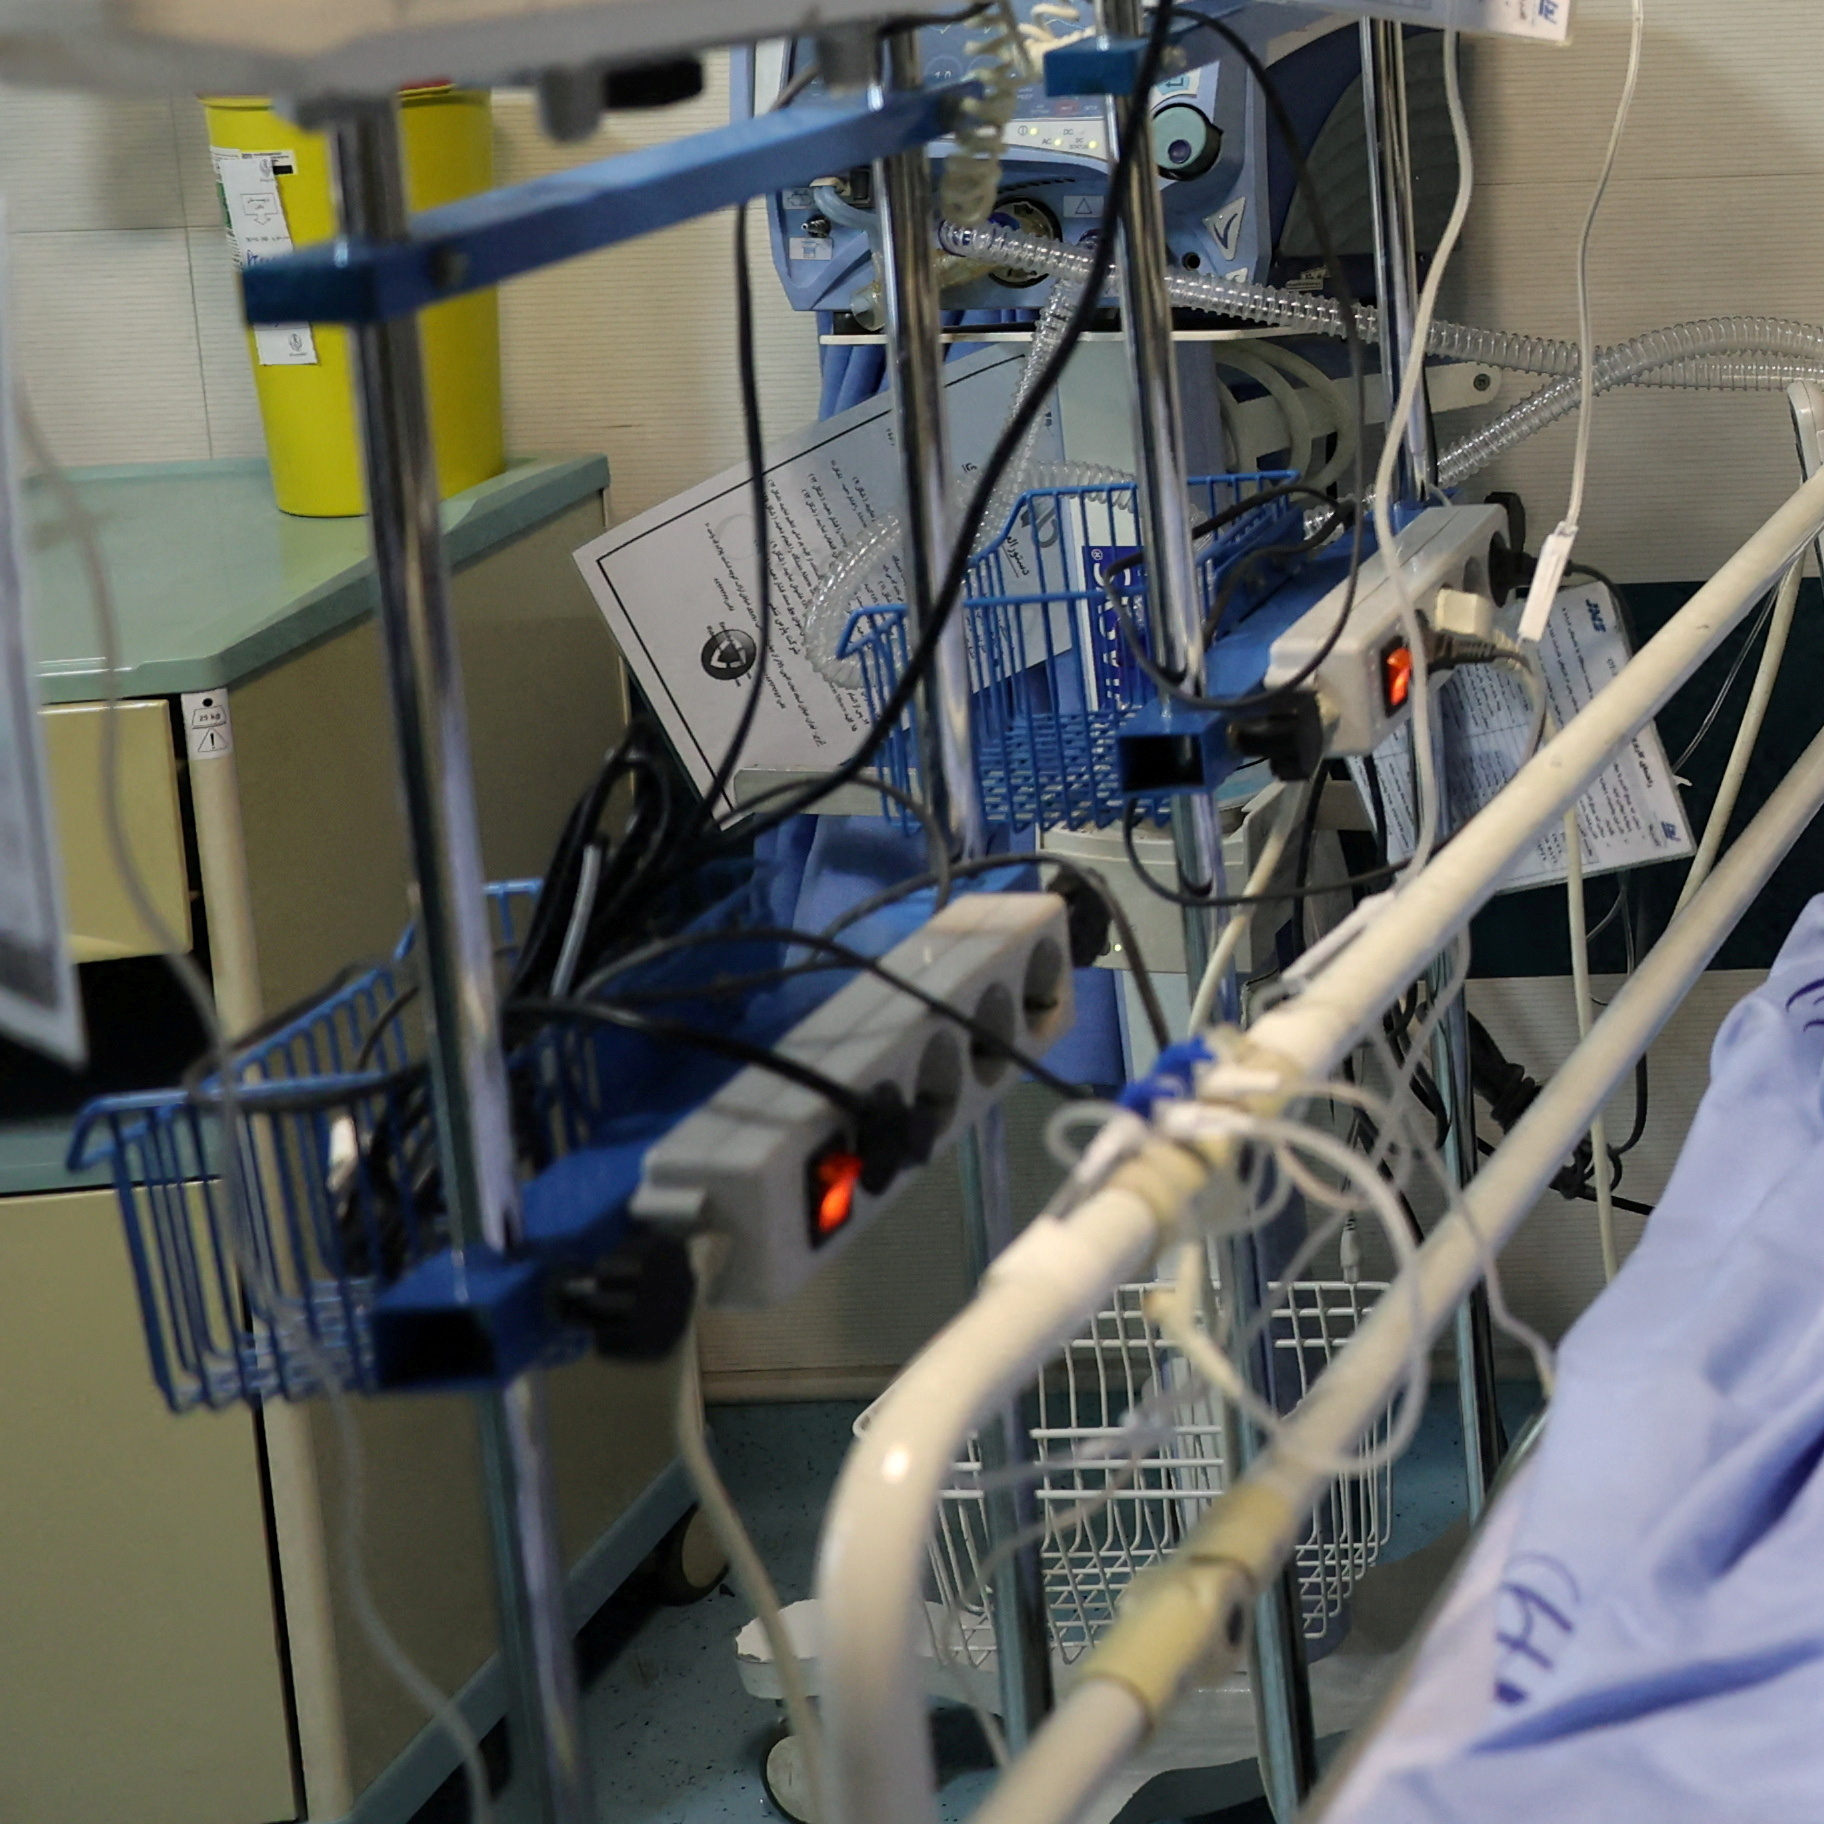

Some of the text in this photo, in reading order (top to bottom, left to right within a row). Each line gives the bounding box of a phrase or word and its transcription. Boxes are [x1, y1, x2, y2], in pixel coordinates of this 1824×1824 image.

[1583, 598, 1607, 632] JMS
[774, 615, 802, 657] شرکت پارس
[199, 714, 209, 722] 25
